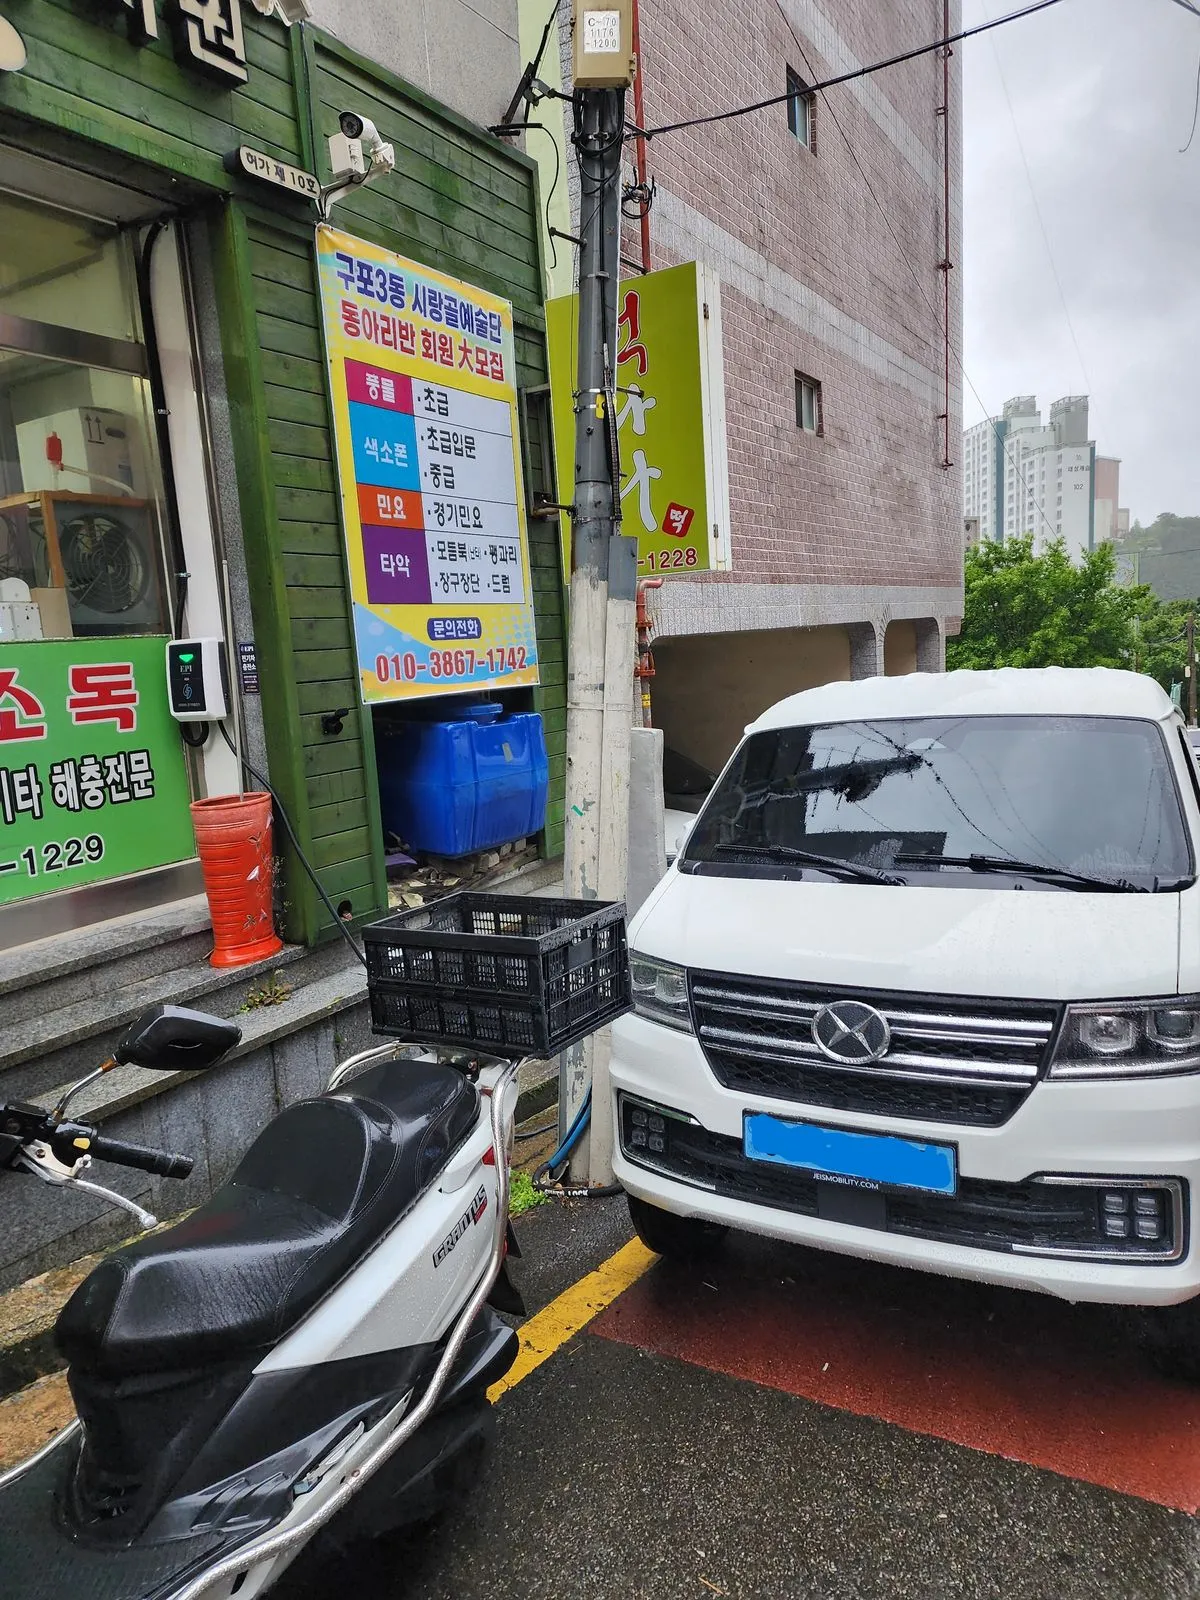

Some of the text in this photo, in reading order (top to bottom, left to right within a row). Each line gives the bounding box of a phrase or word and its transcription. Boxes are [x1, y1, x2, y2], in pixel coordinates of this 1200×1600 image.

[591, 28, 614, 37] 1176
[290, 171, 317, 194] 10호
[335, 252, 405, 309] 구포3동
[341, 299, 416, 356] 동아리반
[420, 328, 455, 367] 회원
[365, 372, 396, 404] 풍물
[423, 387, 450, 417] 초급
[364, 436, 409, 468] 색소폰
[426, 426, 477, 460] 초급입문
[429, 462, 456, 490] 중급
[376, 493, 407, 520] 민요
[433, 502, 484, 529] 경기민요
[380, 553, 411, 578] 타악
[439, 572, 511, 594] 장구장단 드럼
[433, 619, 479, 638] 문의전화
[376, 645, 527, 683] 010-3867-1742
[50, 749, 154, 812] 해충전문
[812, 1172, 880, 1190] JEISMOBILITY.COM
